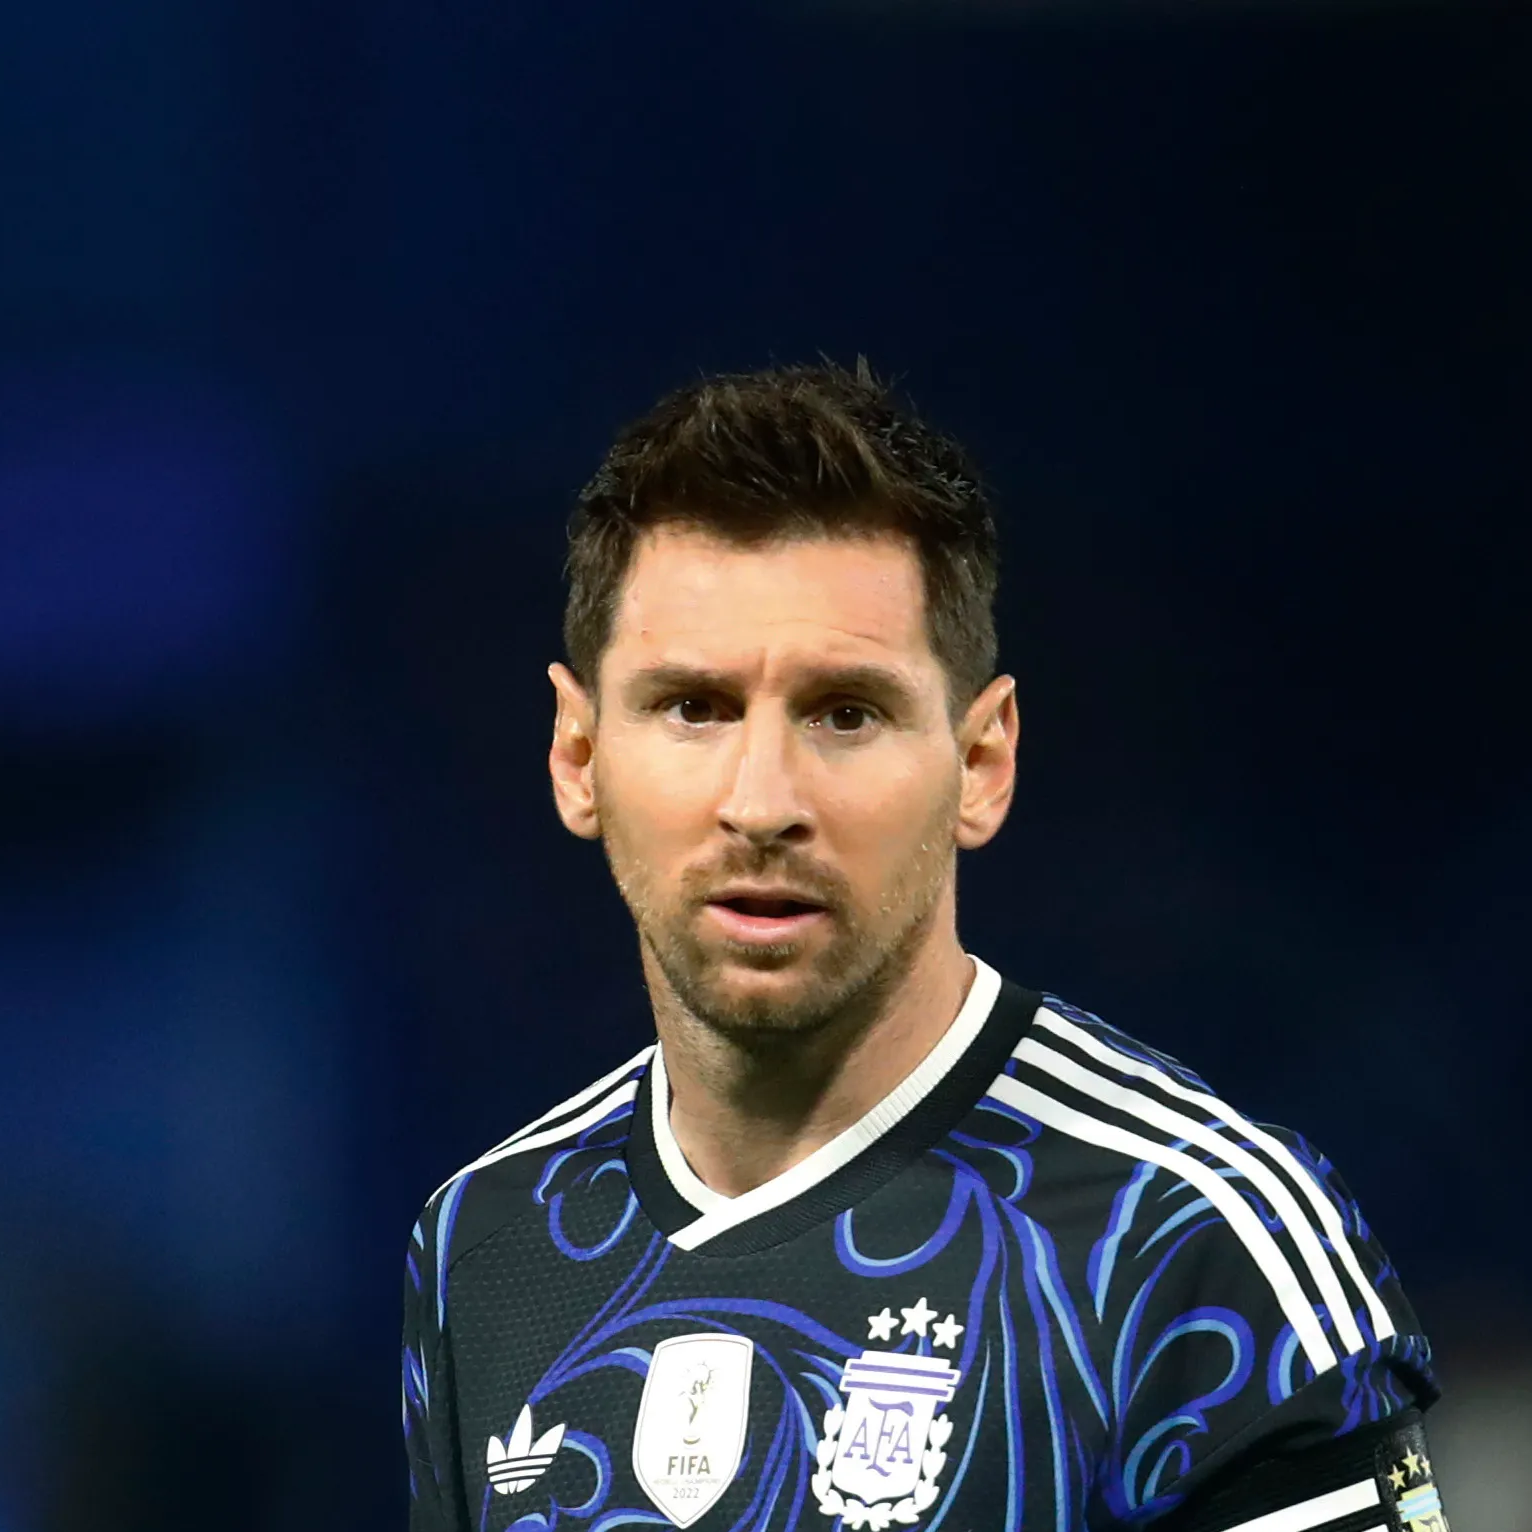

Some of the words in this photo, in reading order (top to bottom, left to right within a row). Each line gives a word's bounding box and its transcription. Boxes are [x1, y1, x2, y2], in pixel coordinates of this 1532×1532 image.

[844, 1397, 914, 1477] AFA
[667, 1456, 711, 1475] FIFA
[673, 1487, 700, 1499] 2022
